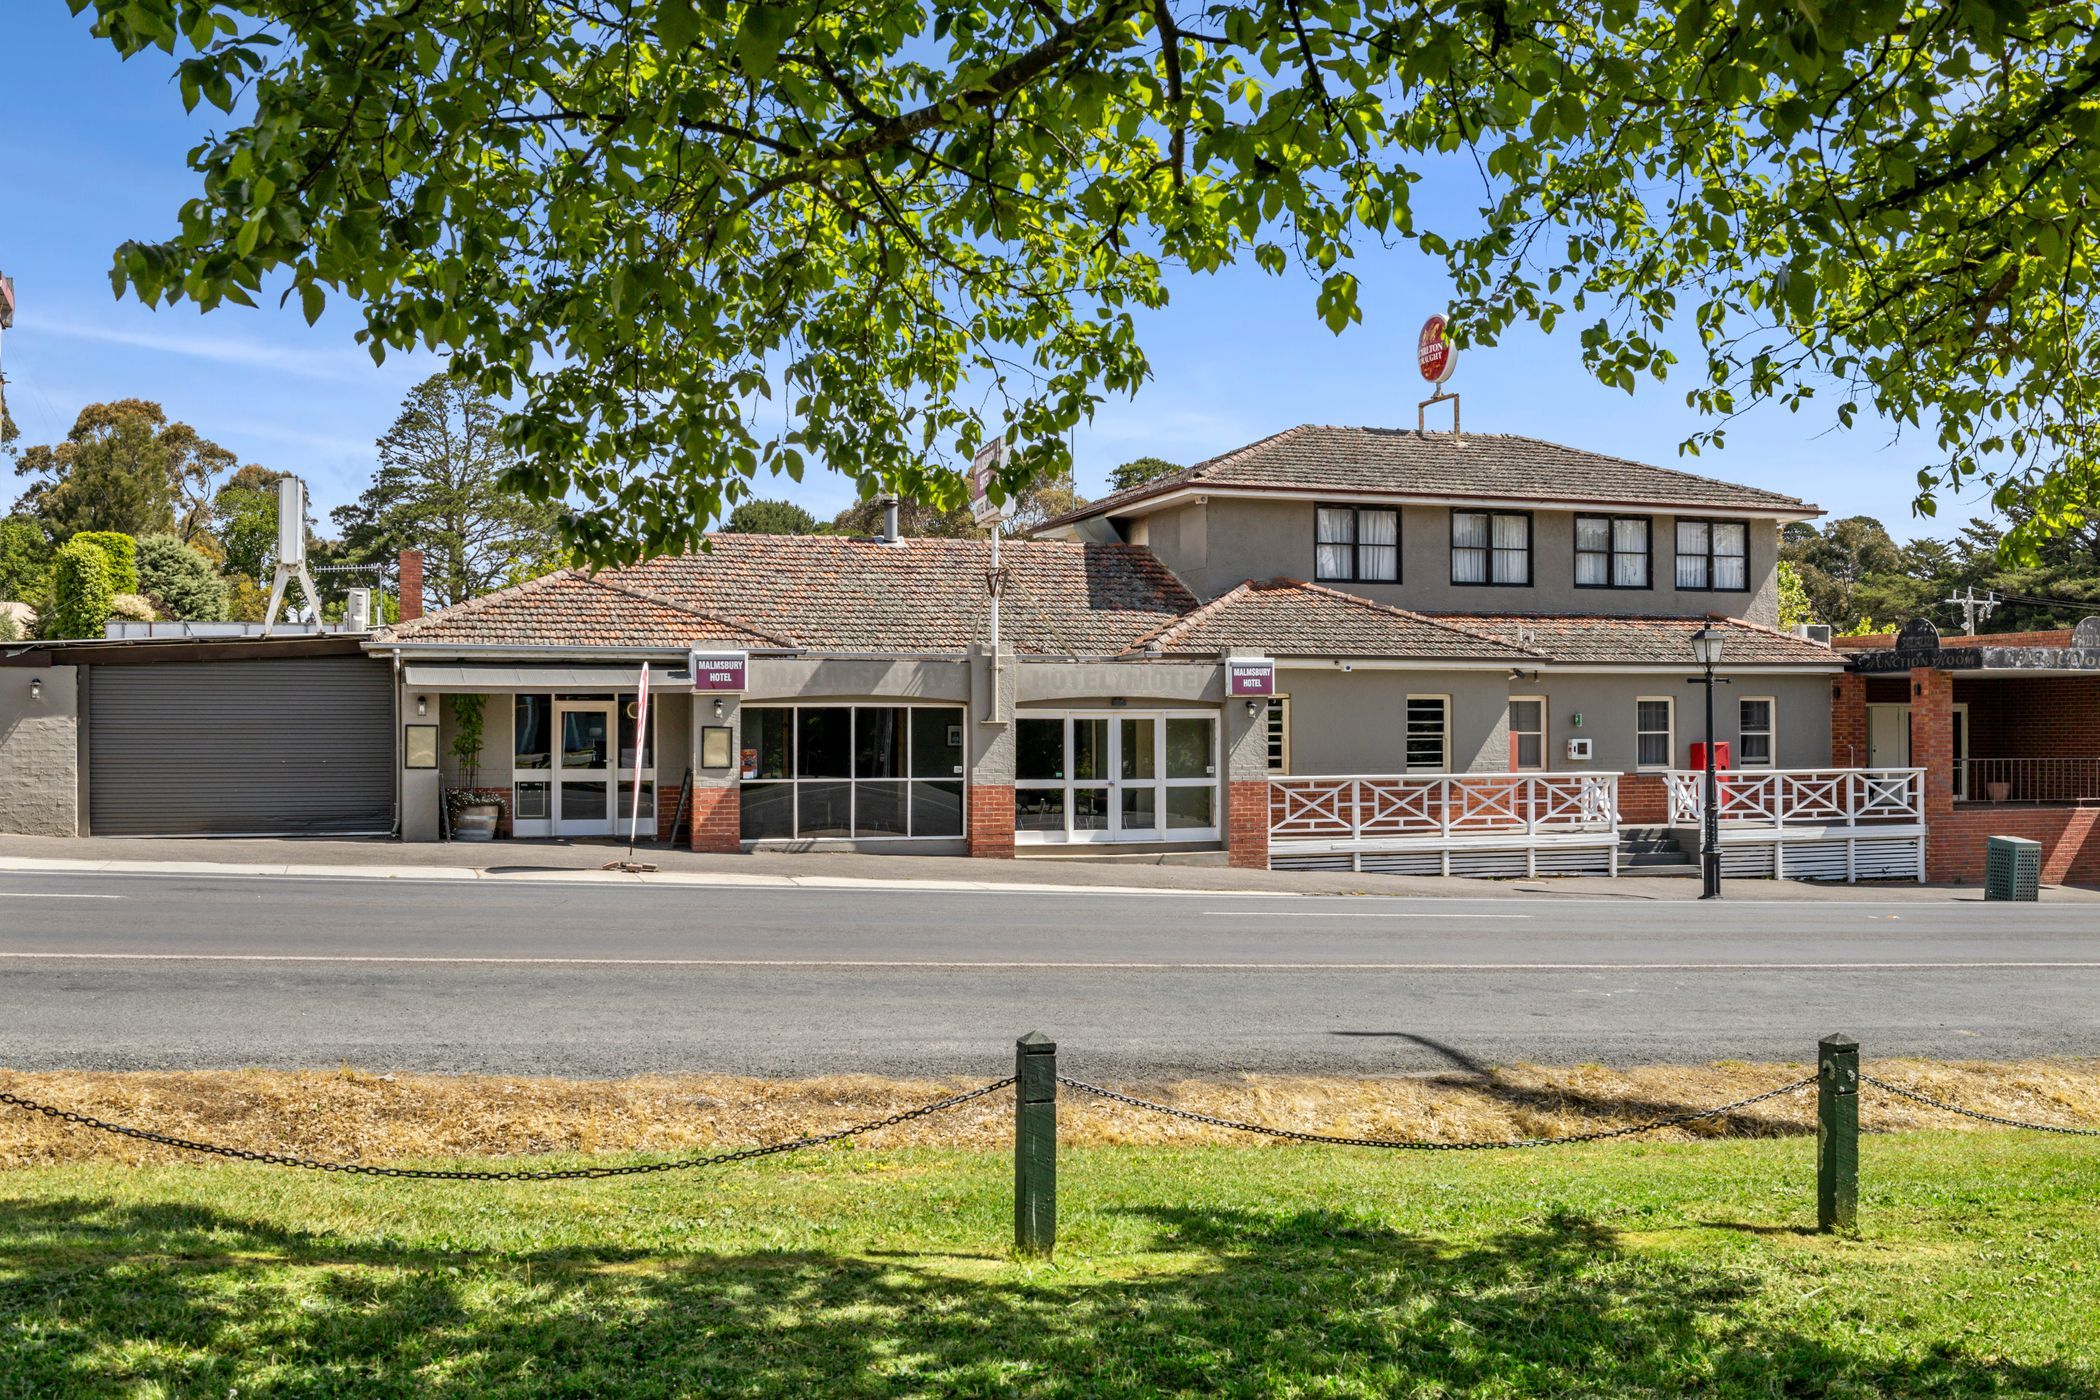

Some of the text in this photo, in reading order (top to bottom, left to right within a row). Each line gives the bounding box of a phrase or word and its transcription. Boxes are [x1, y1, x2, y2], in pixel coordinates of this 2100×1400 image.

[698, 660, 743, 670] MALMSBURY
[1233, 668, 1271, 676] MALMSBURY
[710, 672, 733, 682] HOTEL
[1243, 679, 1262, 687] HOTEL
